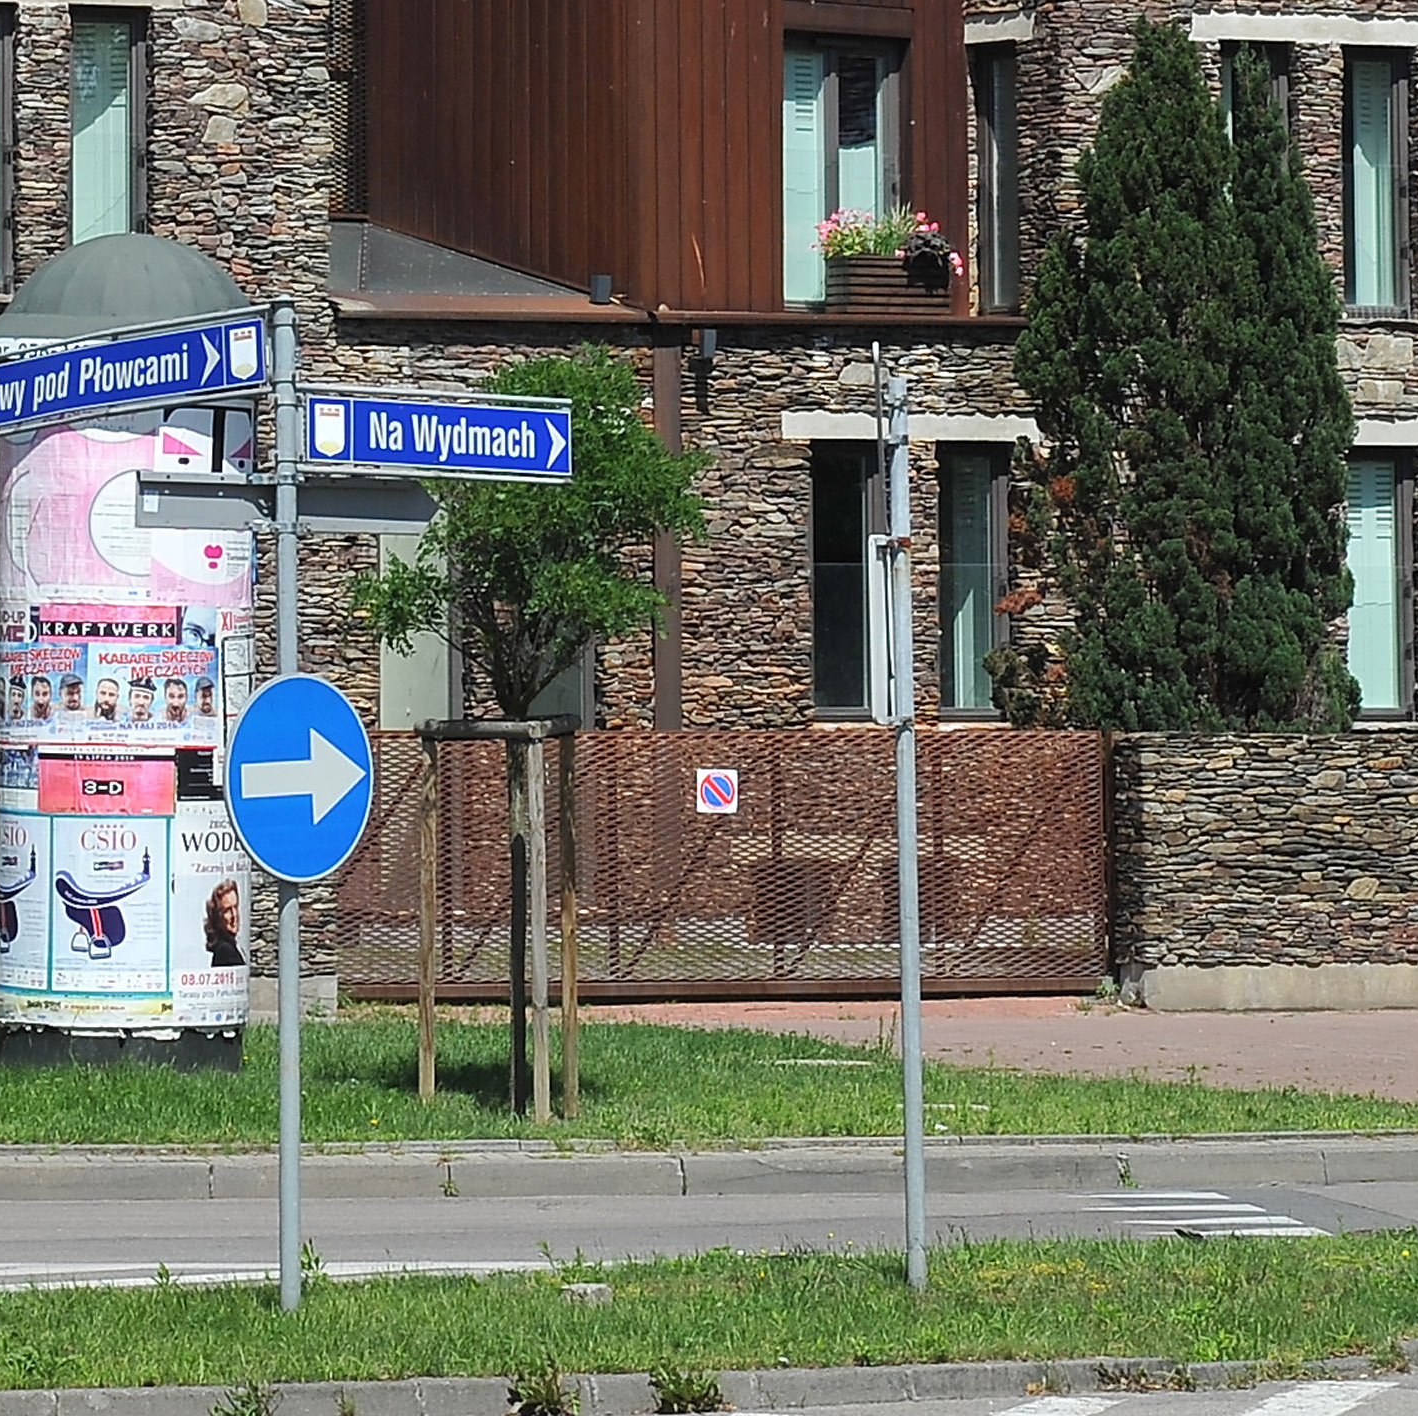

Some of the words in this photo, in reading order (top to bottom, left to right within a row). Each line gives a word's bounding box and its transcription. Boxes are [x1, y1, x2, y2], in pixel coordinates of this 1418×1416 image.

[32, 362, 70, 411] pod
[78, 343, 189, 395] Płowcami
[369, 411, 403, 451] Na
[411, 414, 535, 462] Wydmach
[42, 621, 174, 637] KRAFTWERK
[83, 781, 122, 795] 3-D
[80, 830, 137, 851] CSIO
